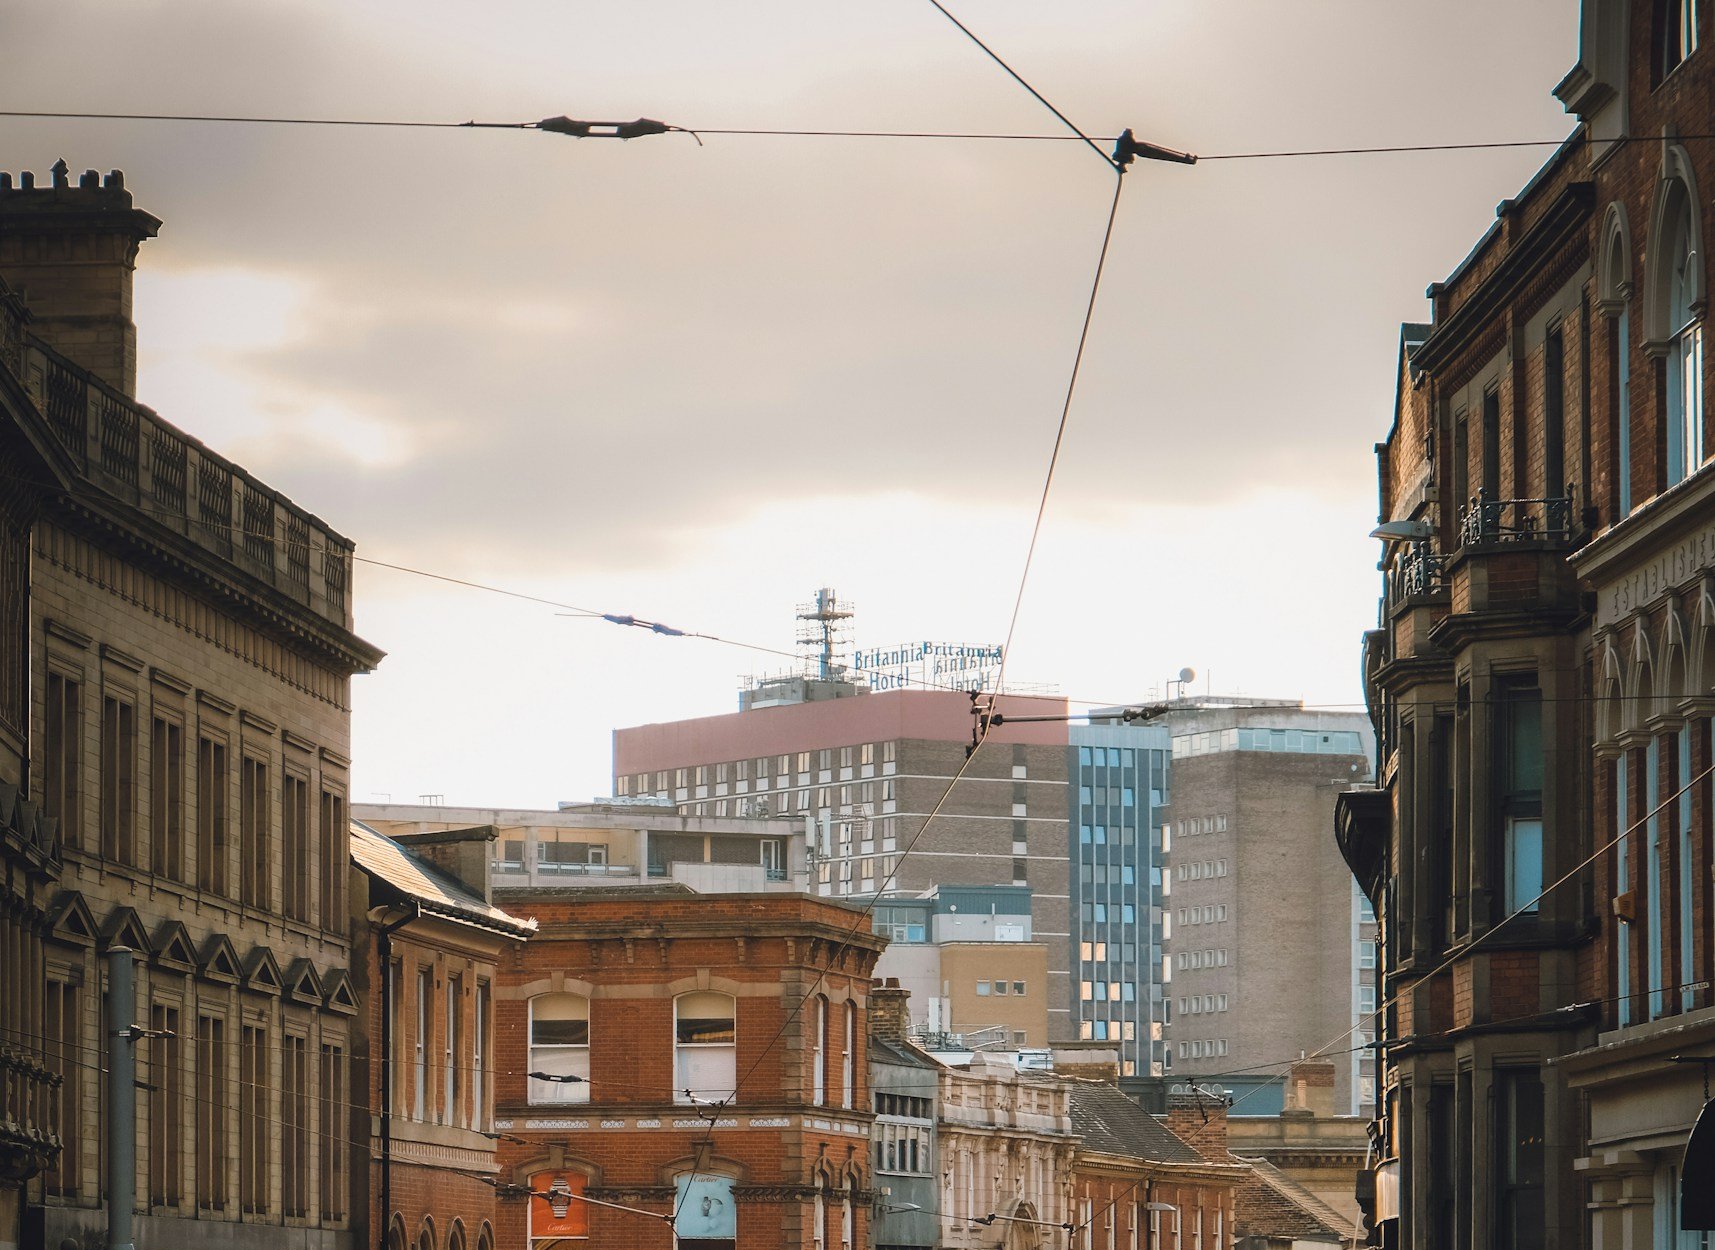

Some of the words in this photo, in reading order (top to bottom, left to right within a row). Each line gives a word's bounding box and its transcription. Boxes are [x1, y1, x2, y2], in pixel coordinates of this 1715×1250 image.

[855, 642, 924, 671] Britannia
[924, 641, 1003, 658] Britannia
[870, 667, 909, 691] Hotel
